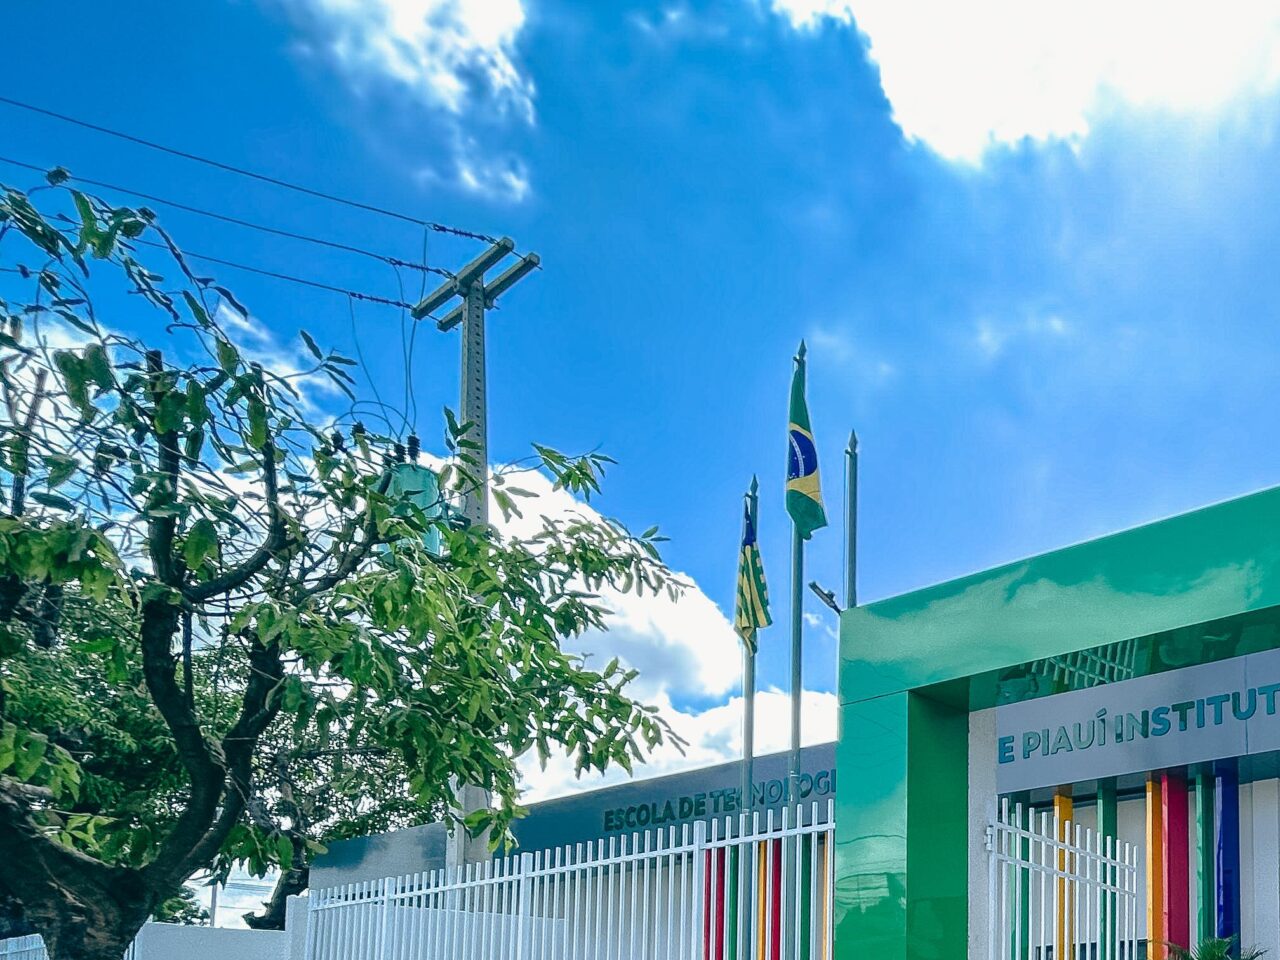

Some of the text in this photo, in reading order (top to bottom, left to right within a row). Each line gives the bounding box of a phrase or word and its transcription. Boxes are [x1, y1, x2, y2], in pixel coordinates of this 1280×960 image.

[998, 735, 1015, 763] E
[1022, 708, 1106, 759] PIAUÍ
[604, 800, 676, 832] ESCOLA
[678, 792, 707, 818] DE
